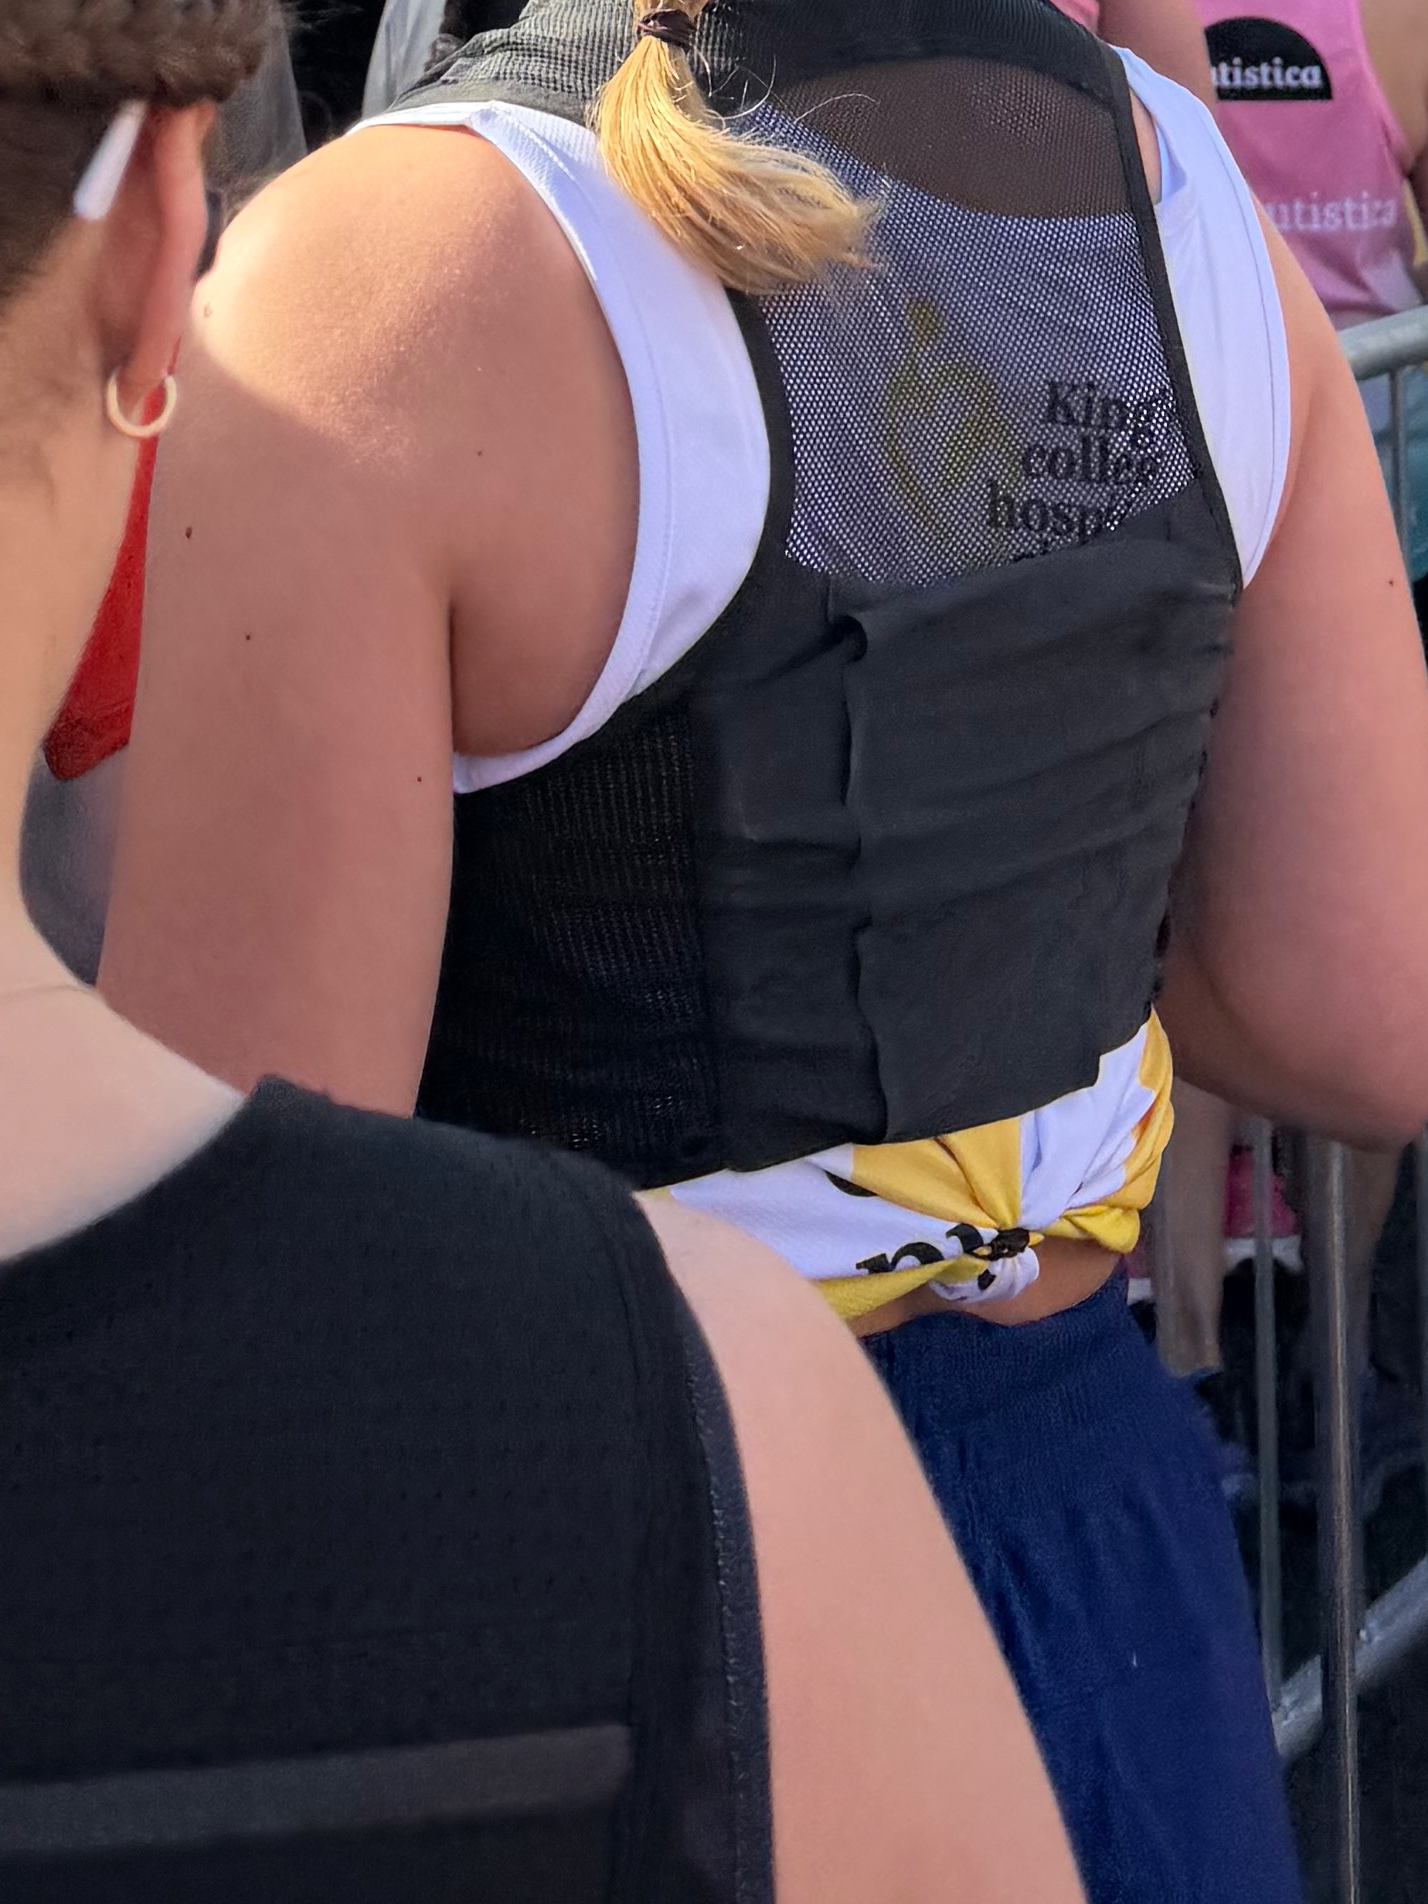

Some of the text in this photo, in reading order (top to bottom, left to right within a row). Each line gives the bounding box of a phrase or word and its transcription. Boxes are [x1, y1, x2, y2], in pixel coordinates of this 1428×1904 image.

[1210, 56, 1322, 89] tistica
[1043, 377, 1169, 450] King
[984, 476, 1115, 547] hosp
